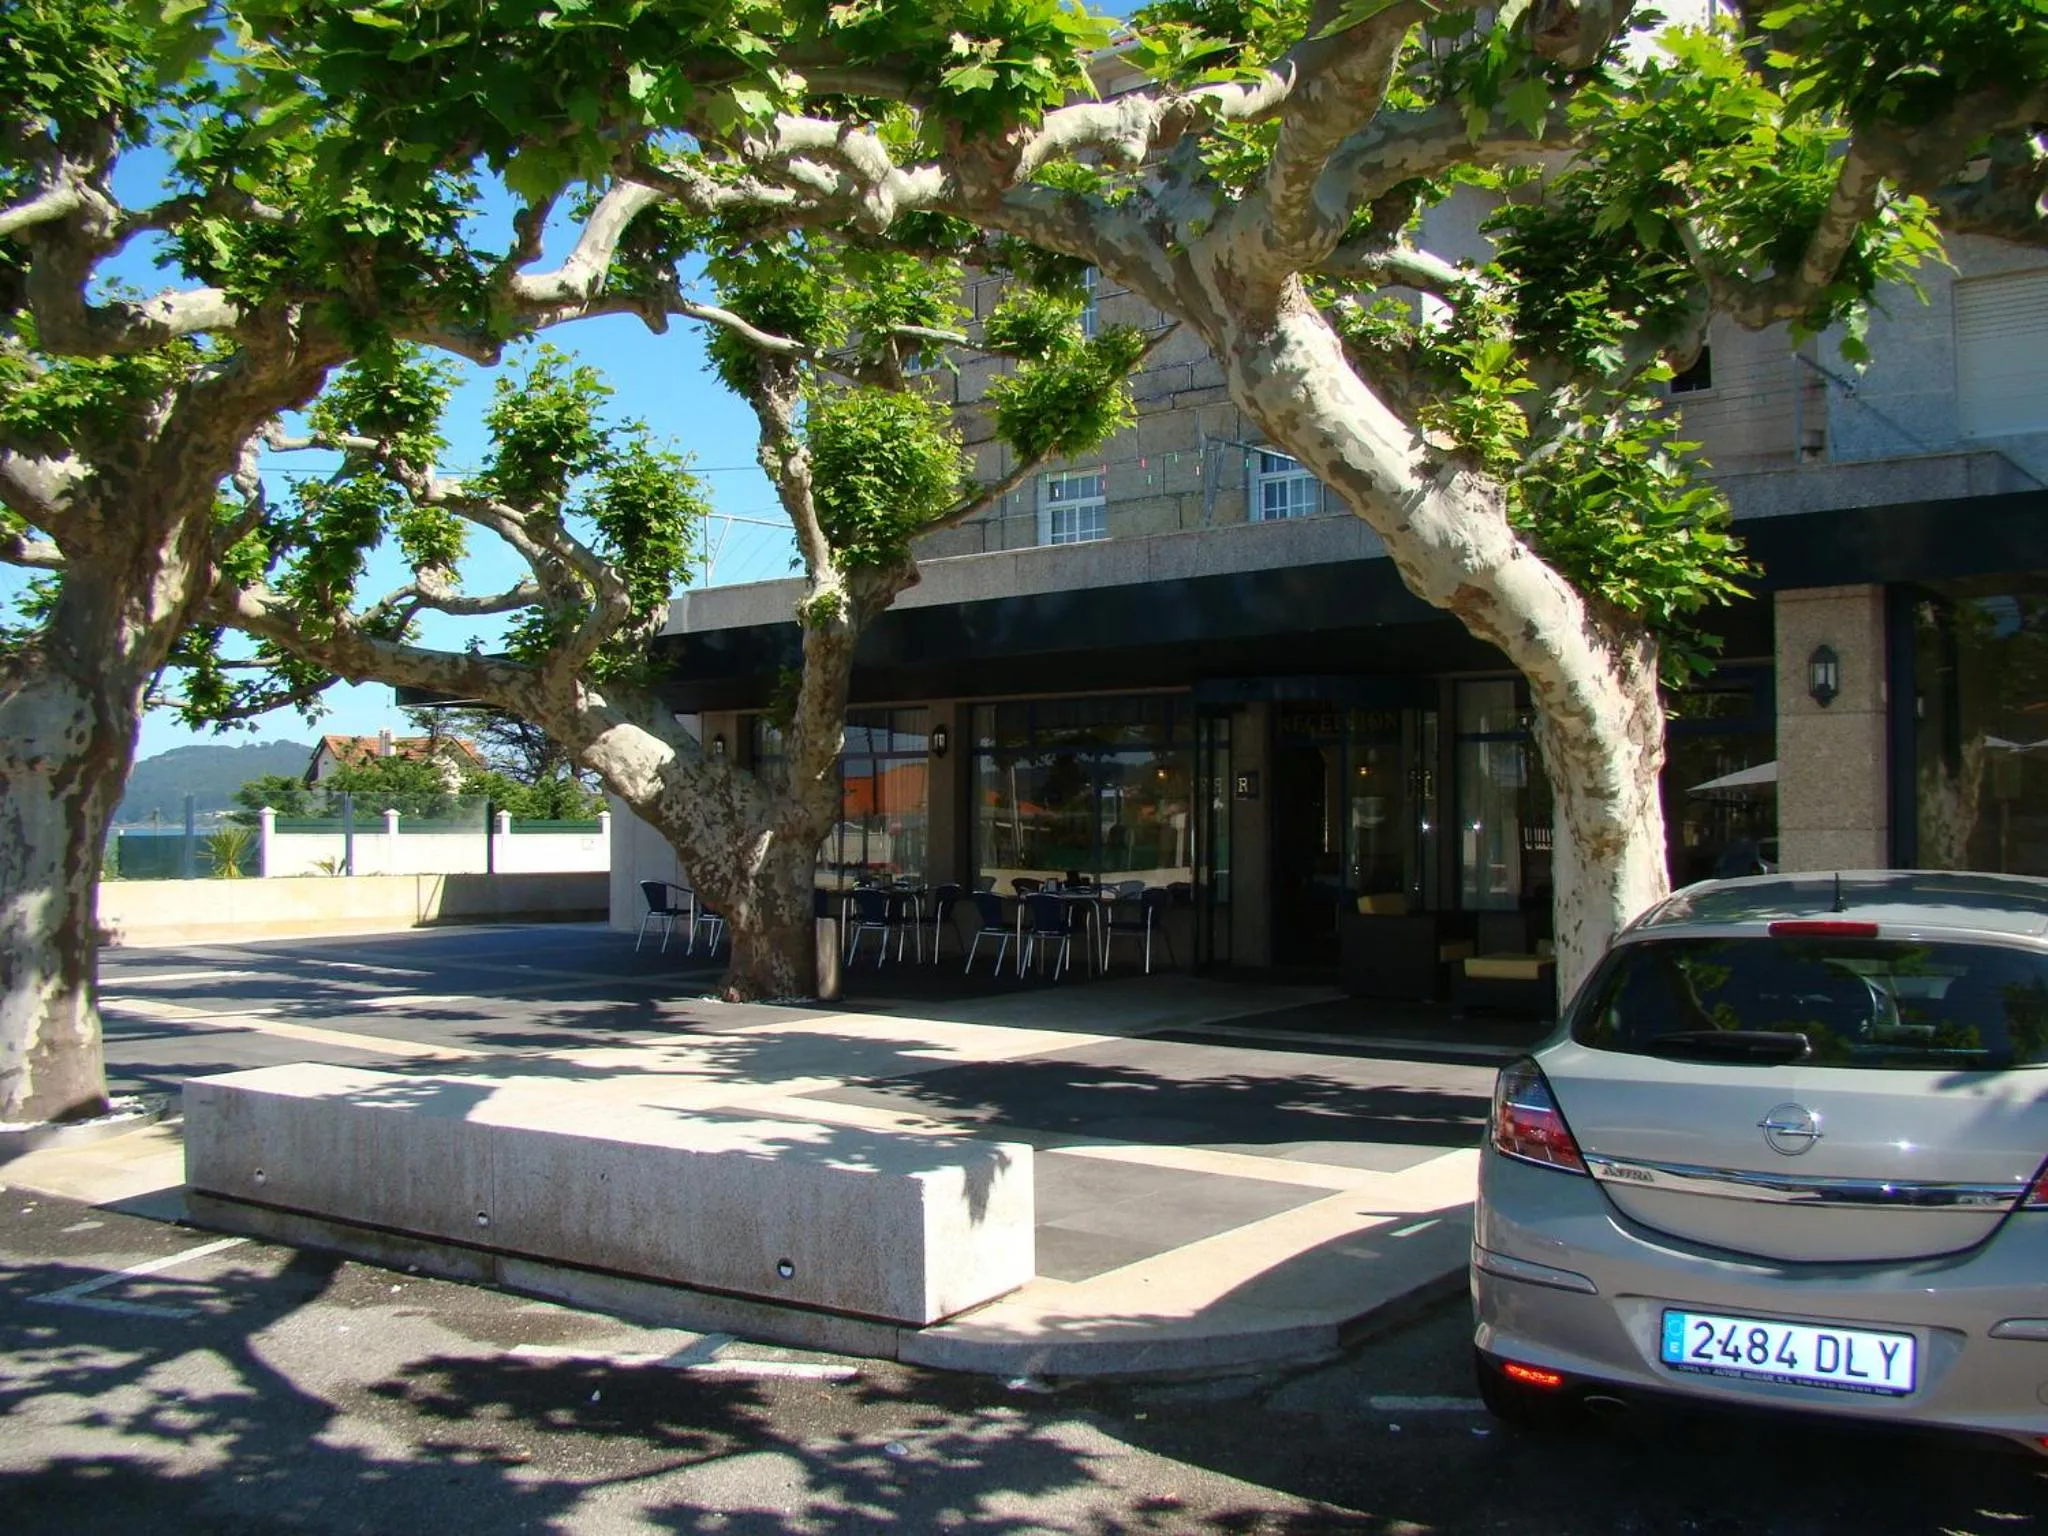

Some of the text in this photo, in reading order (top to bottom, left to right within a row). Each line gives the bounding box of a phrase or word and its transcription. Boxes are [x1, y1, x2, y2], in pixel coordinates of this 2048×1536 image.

[1603, 1166, 1654, 1182] ASTRA
[1670, 1320, 1900, 1380] E 2484 DLY
